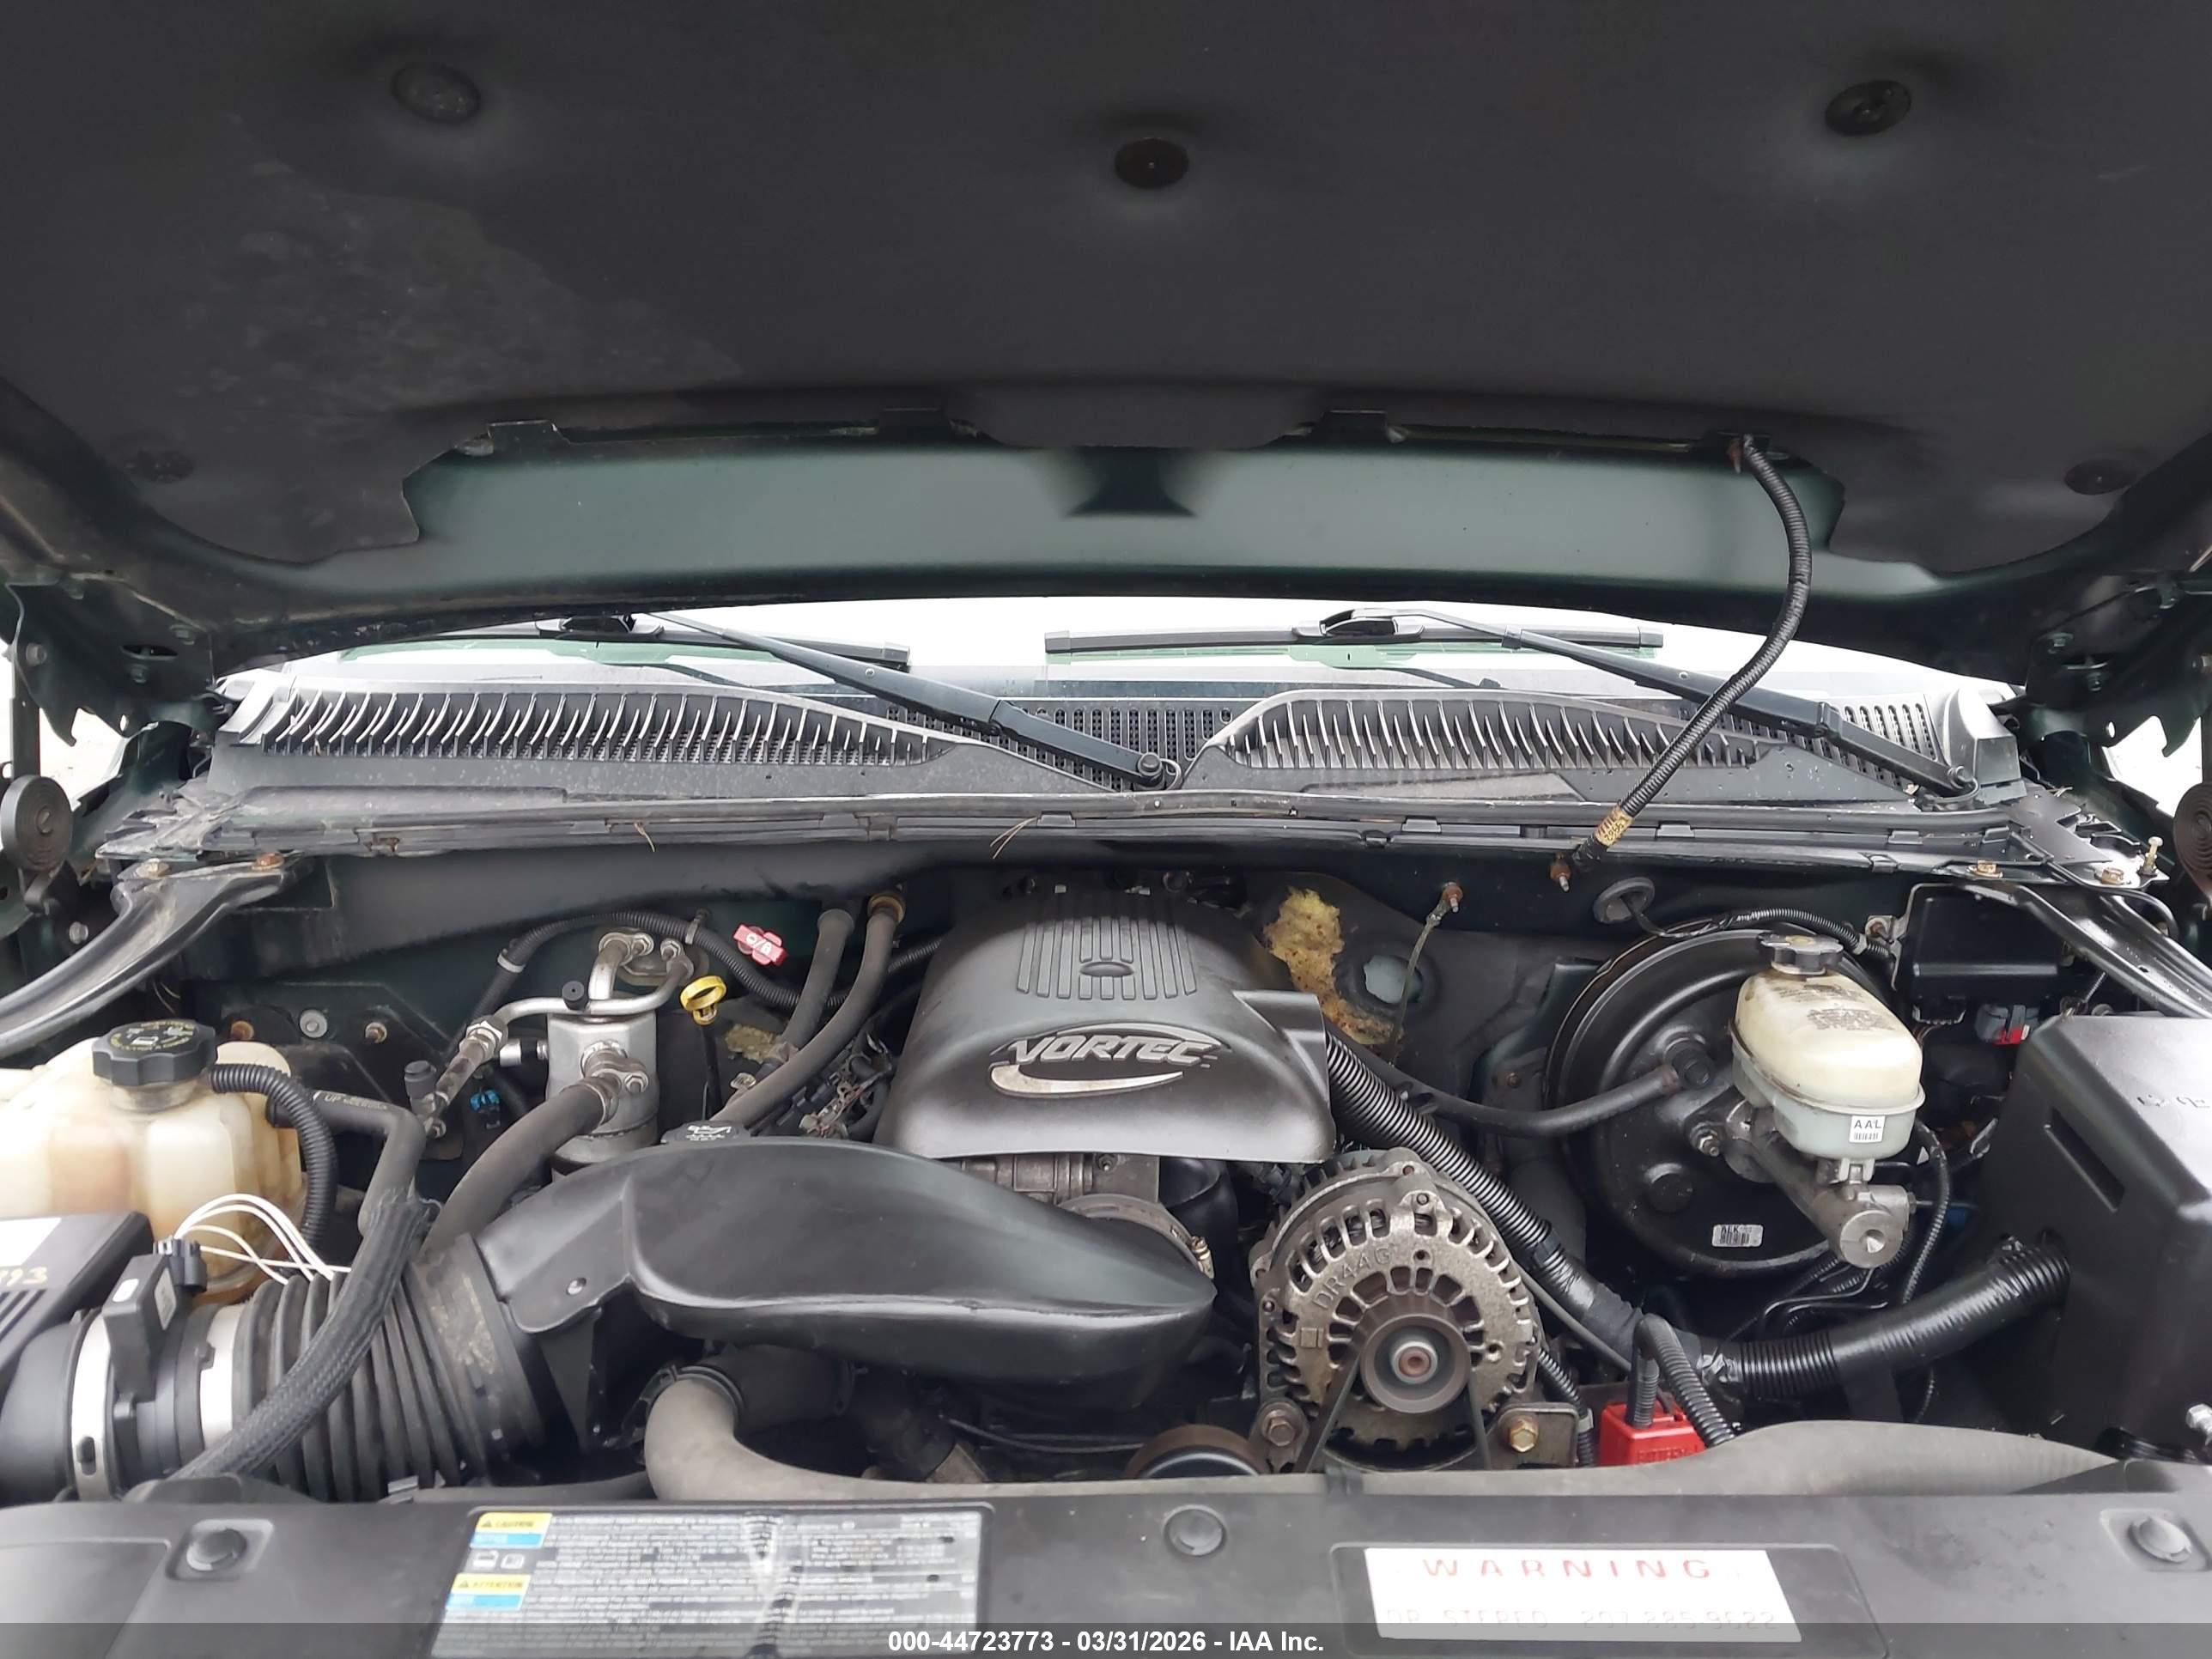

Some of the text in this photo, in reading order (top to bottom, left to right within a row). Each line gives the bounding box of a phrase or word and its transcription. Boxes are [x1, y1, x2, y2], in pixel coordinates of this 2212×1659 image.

[1006, 1034, 1213, 1066] VORTEC
[1854, 1119, 1882, 1129] AAL
[1422, 1559, 1711, 1579] WARNING
